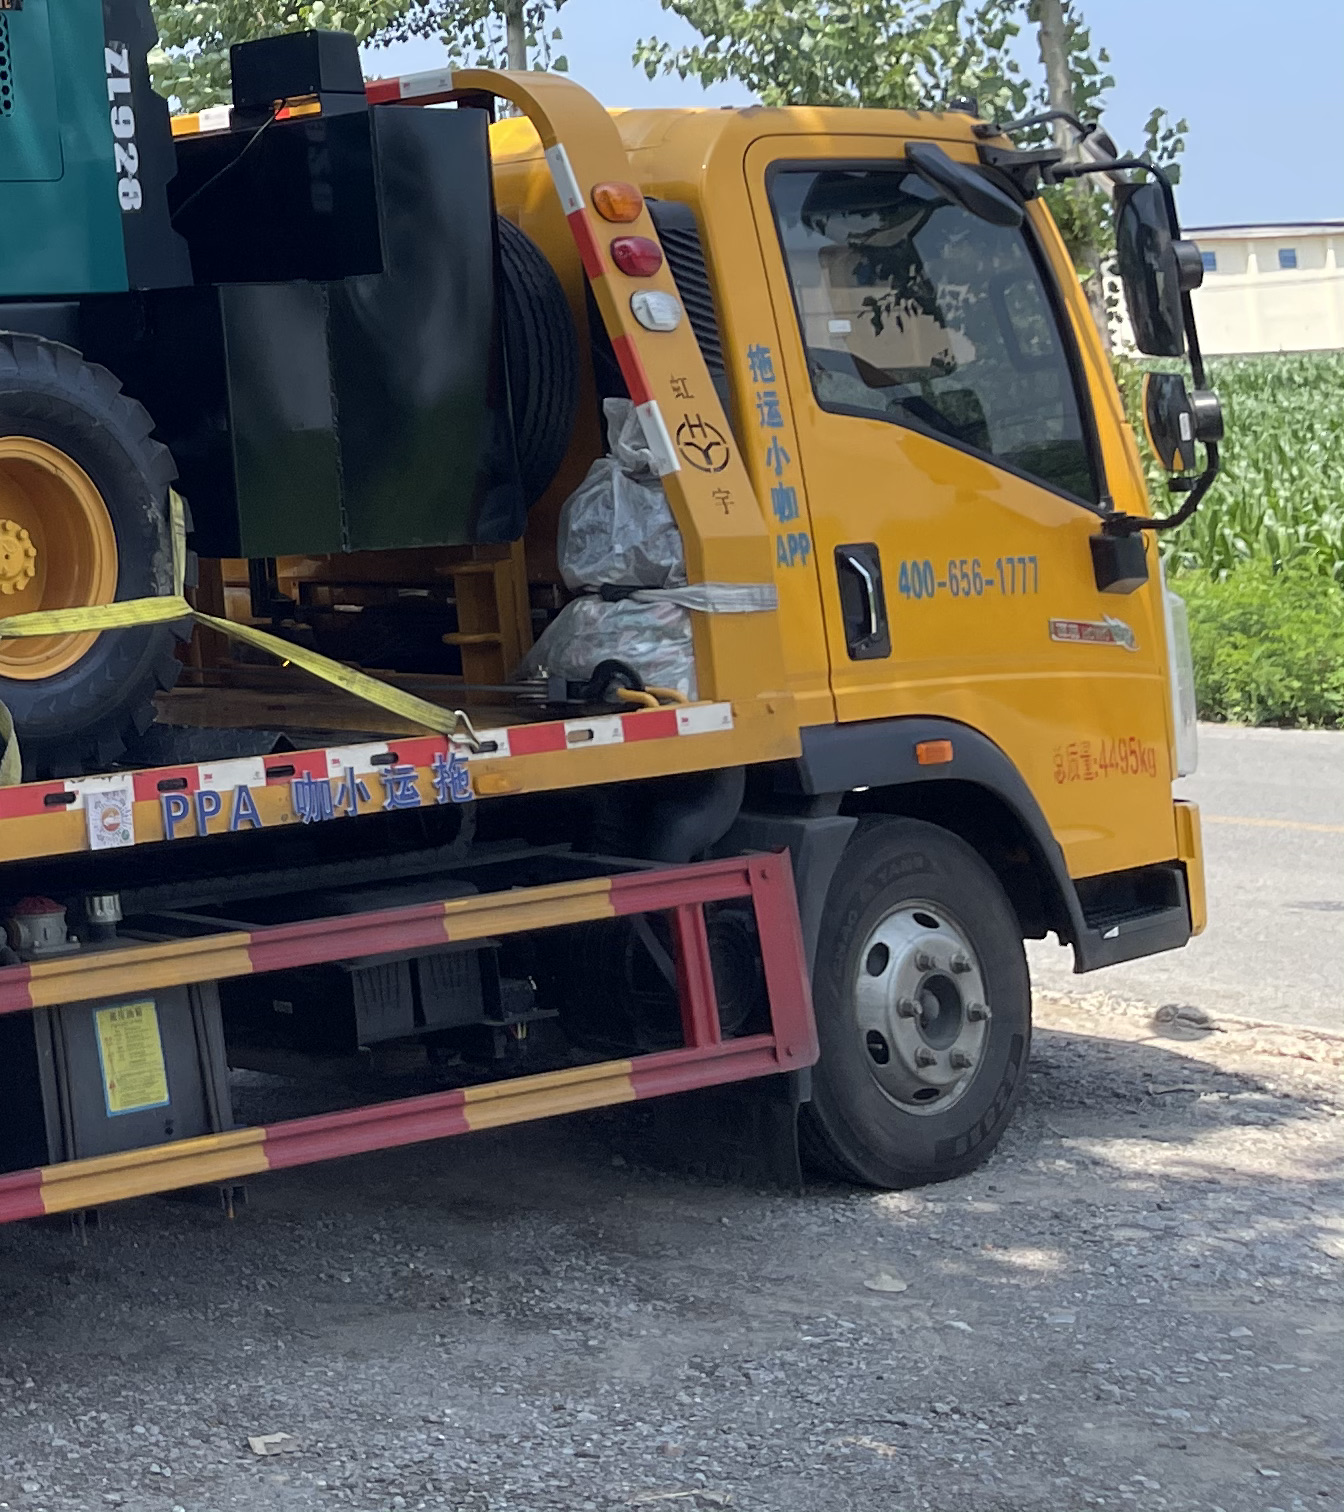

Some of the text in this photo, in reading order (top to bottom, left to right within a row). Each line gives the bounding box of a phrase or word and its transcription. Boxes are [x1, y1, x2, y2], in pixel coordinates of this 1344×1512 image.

[104, 47, 143, 211] ZL928
[776, 532, 811, 569] APP
[898, 555, 1039, 600] 400-656-1777
[160, 784, 263, 841] PPA
[290, 751, 475, 825] 咖小运拖
